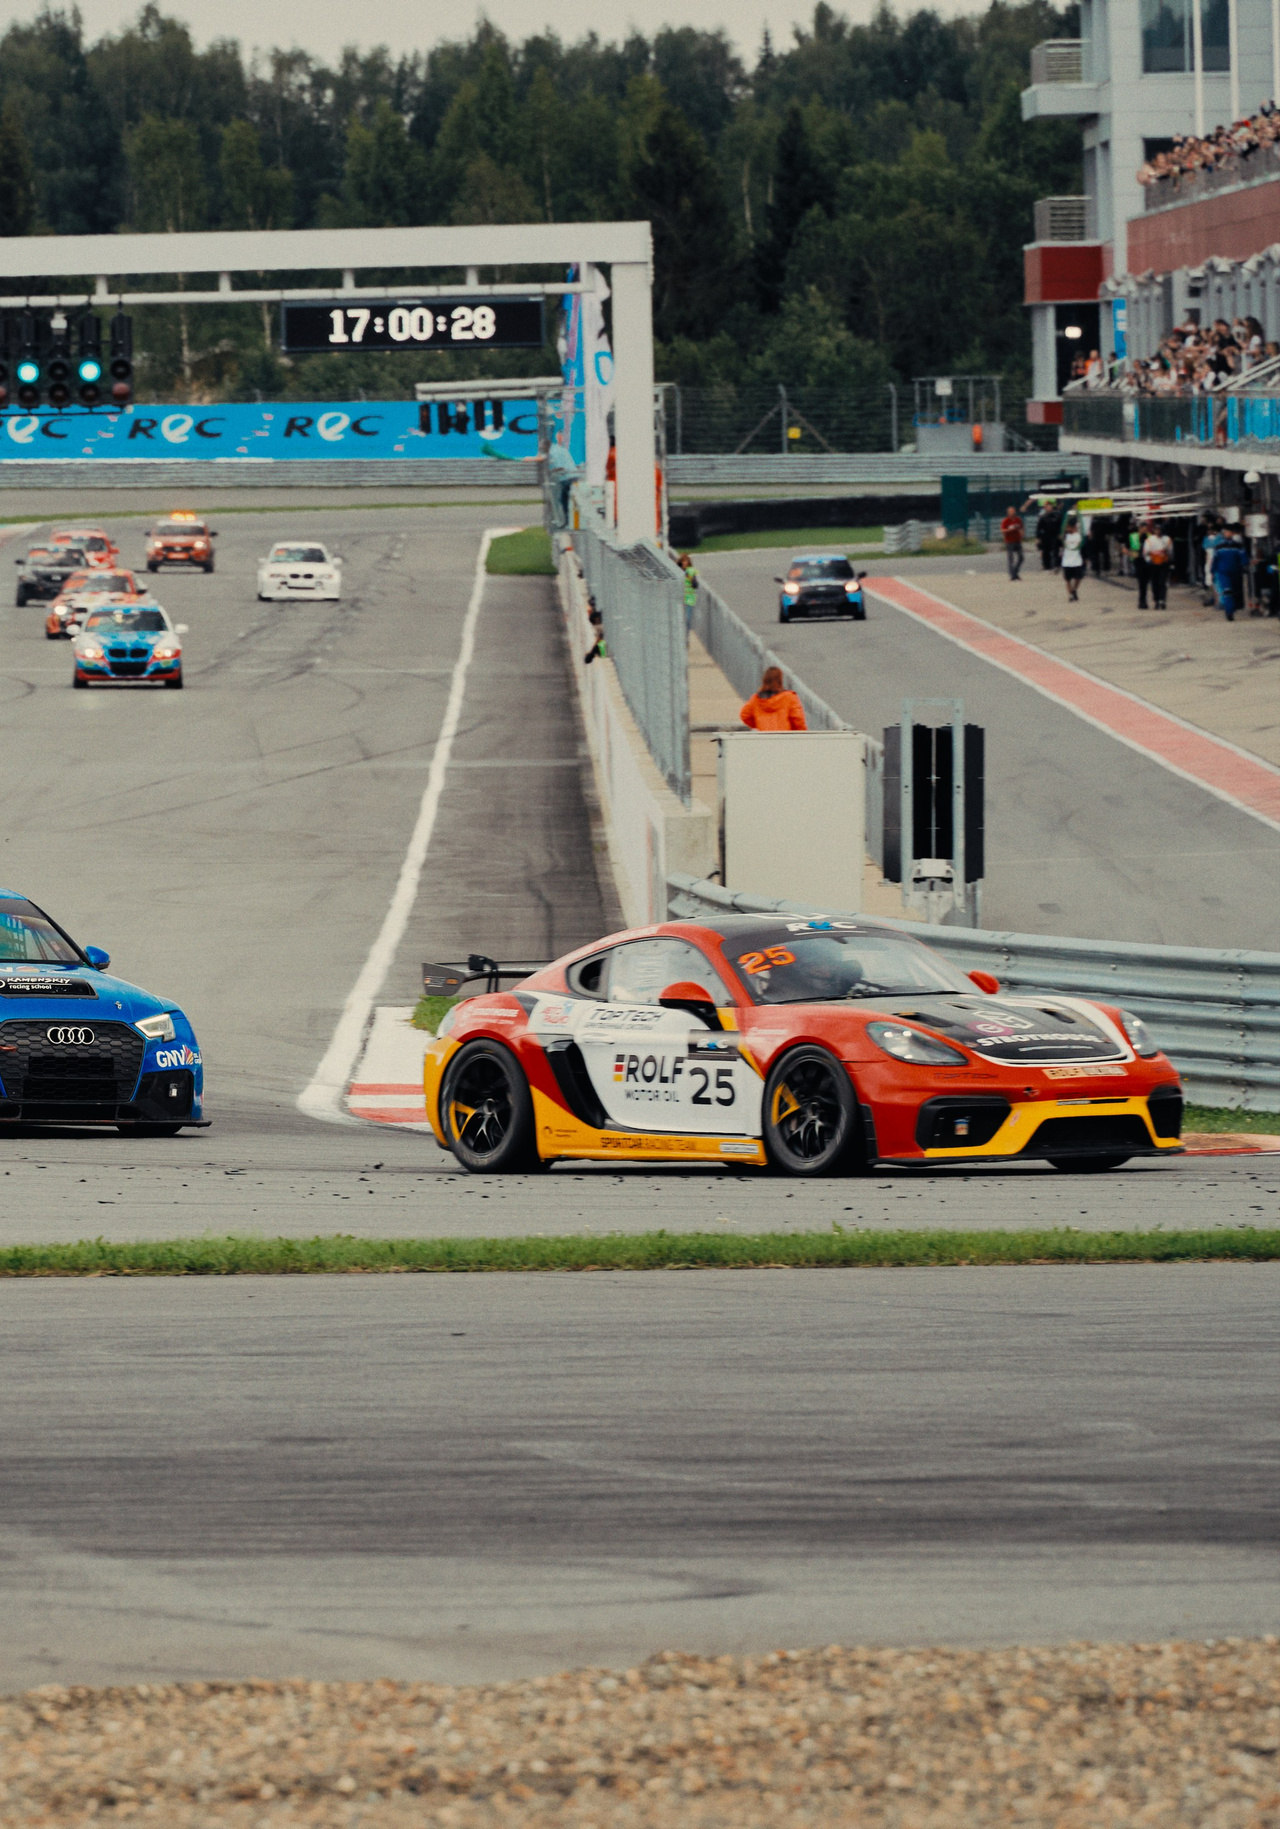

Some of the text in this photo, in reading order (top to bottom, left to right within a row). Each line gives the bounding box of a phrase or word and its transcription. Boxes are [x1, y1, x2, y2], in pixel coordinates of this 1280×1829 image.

[329, 306, 496, 343] 17:00:28
[738, 945, 797, 975] 25
[156, 1049, 186, 1068] GNV
[625, 1054, 685, 1084] ROLF
[663, 1090, 680, 1102] OIL
[689, 1067, 736, 1107] 25
